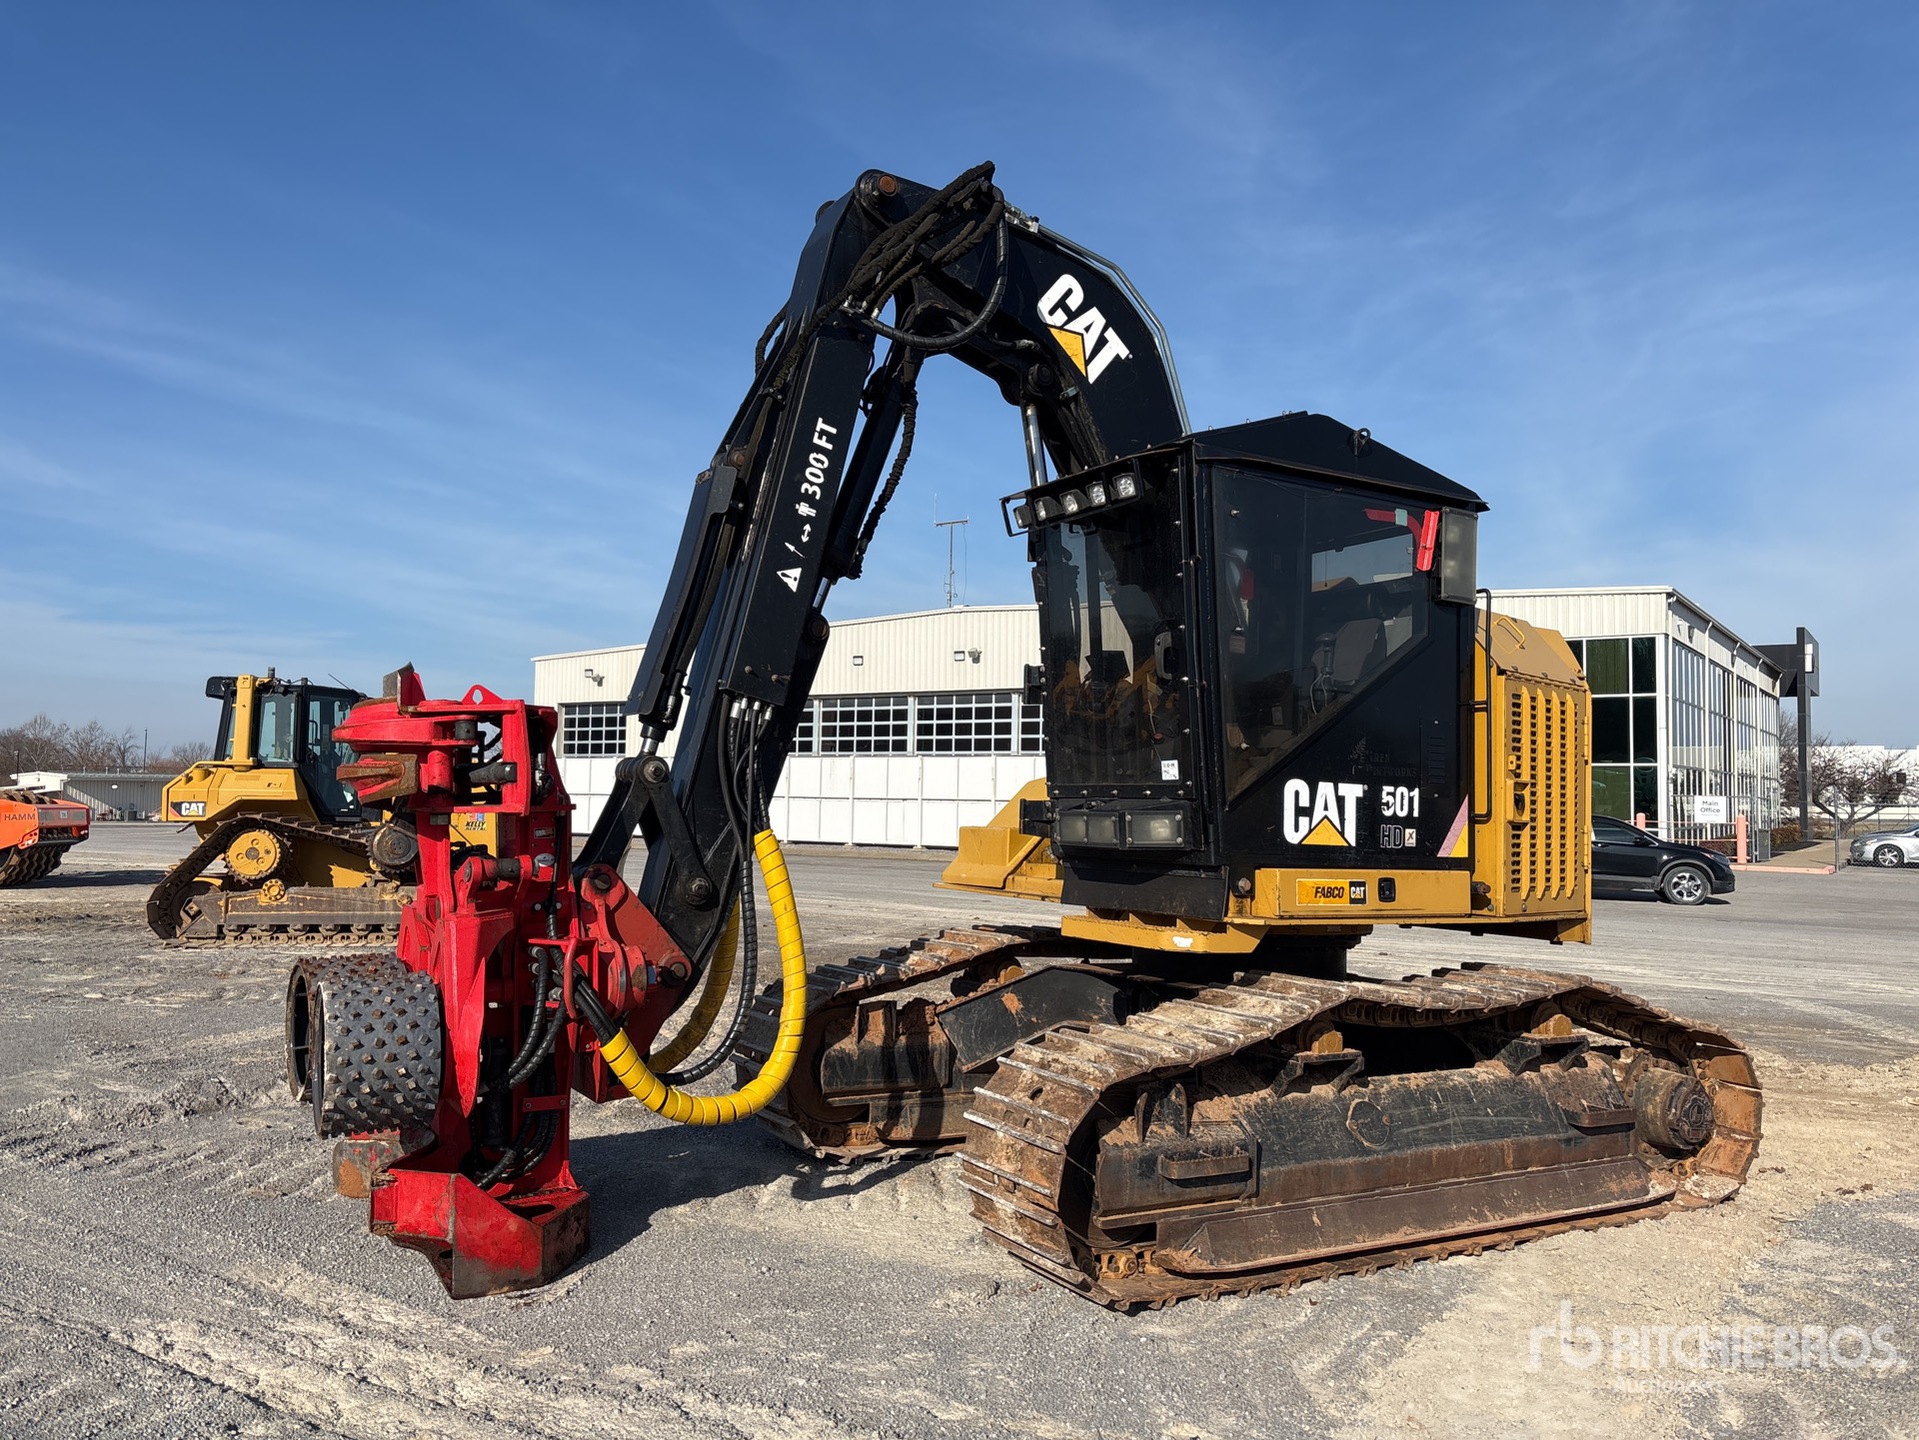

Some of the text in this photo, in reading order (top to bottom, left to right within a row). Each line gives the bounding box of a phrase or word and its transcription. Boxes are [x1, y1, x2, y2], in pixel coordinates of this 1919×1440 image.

[1037, 274, 1131, 384] CAT
[801, 417, 838, 500] 300 FT
[4, 813, 36, 821] HAMM
[181, 802, 205, 816] CAT
[1283, 778, 1364, 847] CAT
[1381, 785, 1419, 817] 501
[1314, 886, 1366, 899] FABCO CAT
